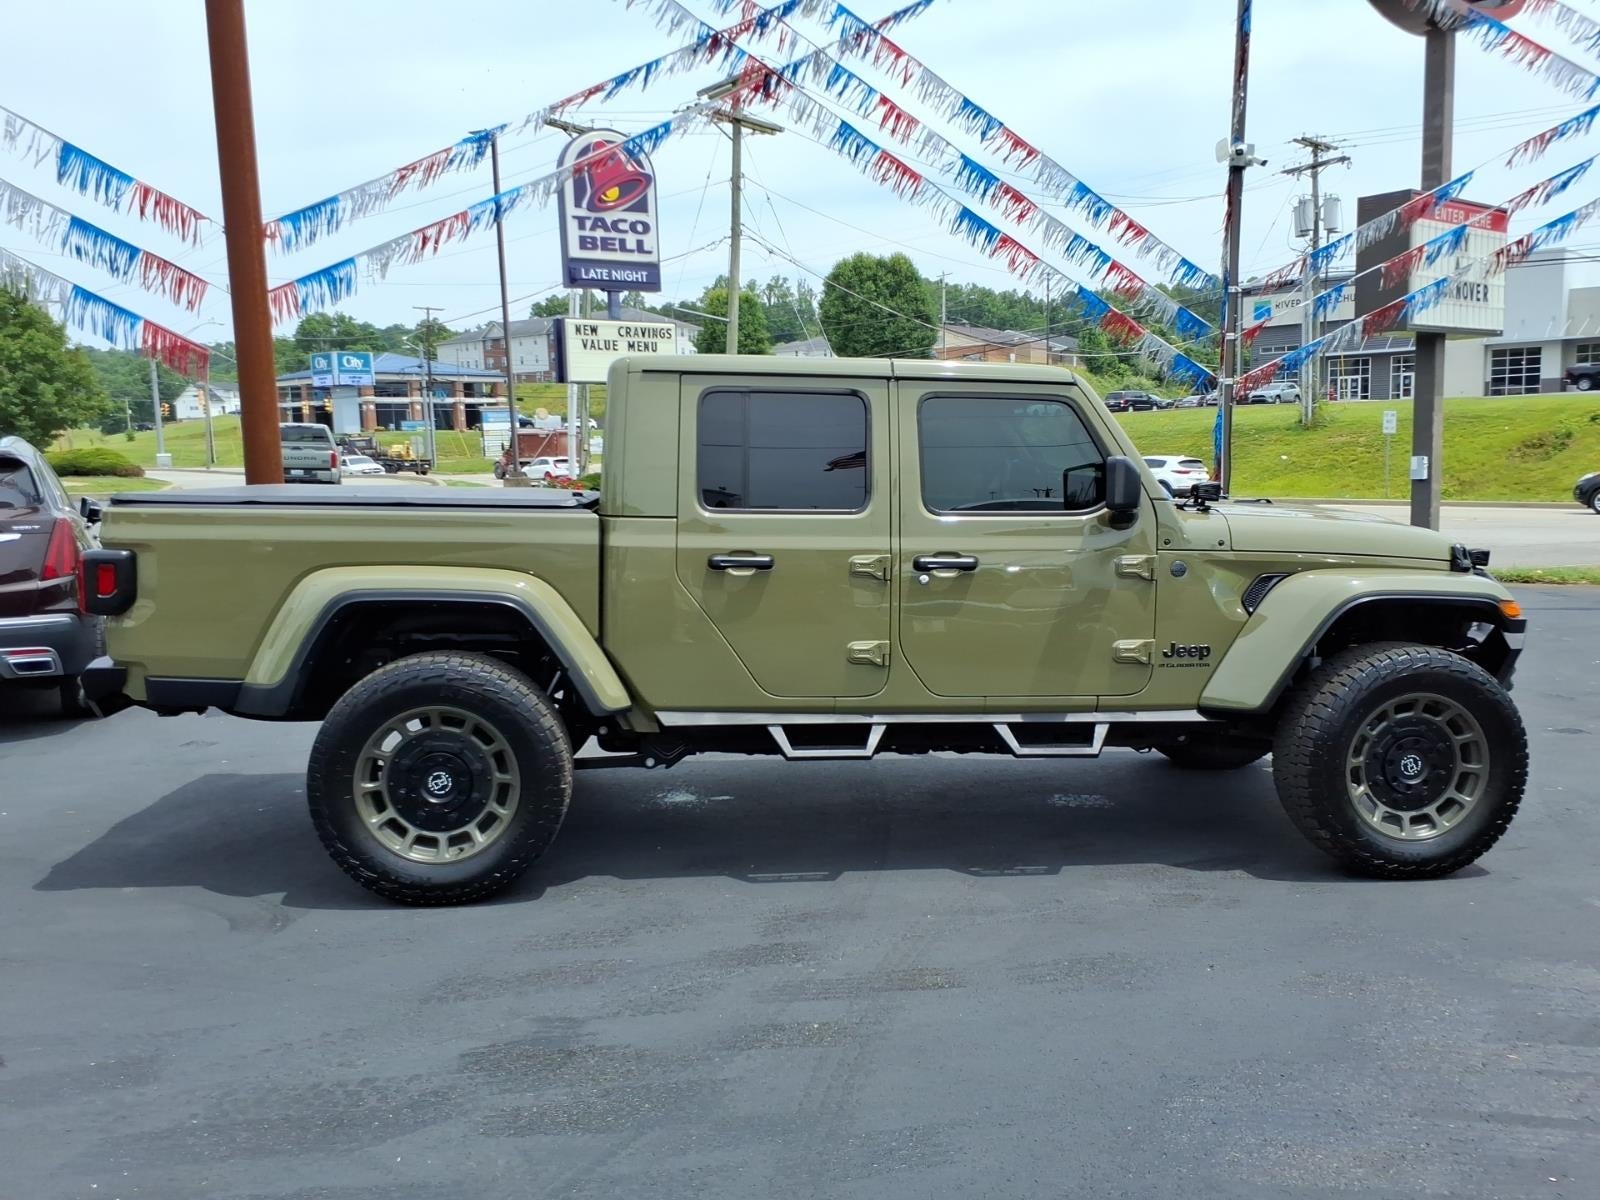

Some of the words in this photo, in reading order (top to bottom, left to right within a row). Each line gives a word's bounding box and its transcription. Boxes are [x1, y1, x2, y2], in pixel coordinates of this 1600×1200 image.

[1435, 207, 1465, 224] ENTER
[572, 215, 651, 235] TACO
[579, 235, 653, 254] BELL
[582, 266, 609, 280] LATE
[612, 269, 648, 282] NIGHT
[575, 324, 598, 336] NEW
[617, 326, 672, 339] CRAVINGS
[582, 339, 618, 351] VALUE
[628, 341, 658, 353] MENU
[343, 355, 364, 370] City
[1162, 640, 1211, 661] Jeep
